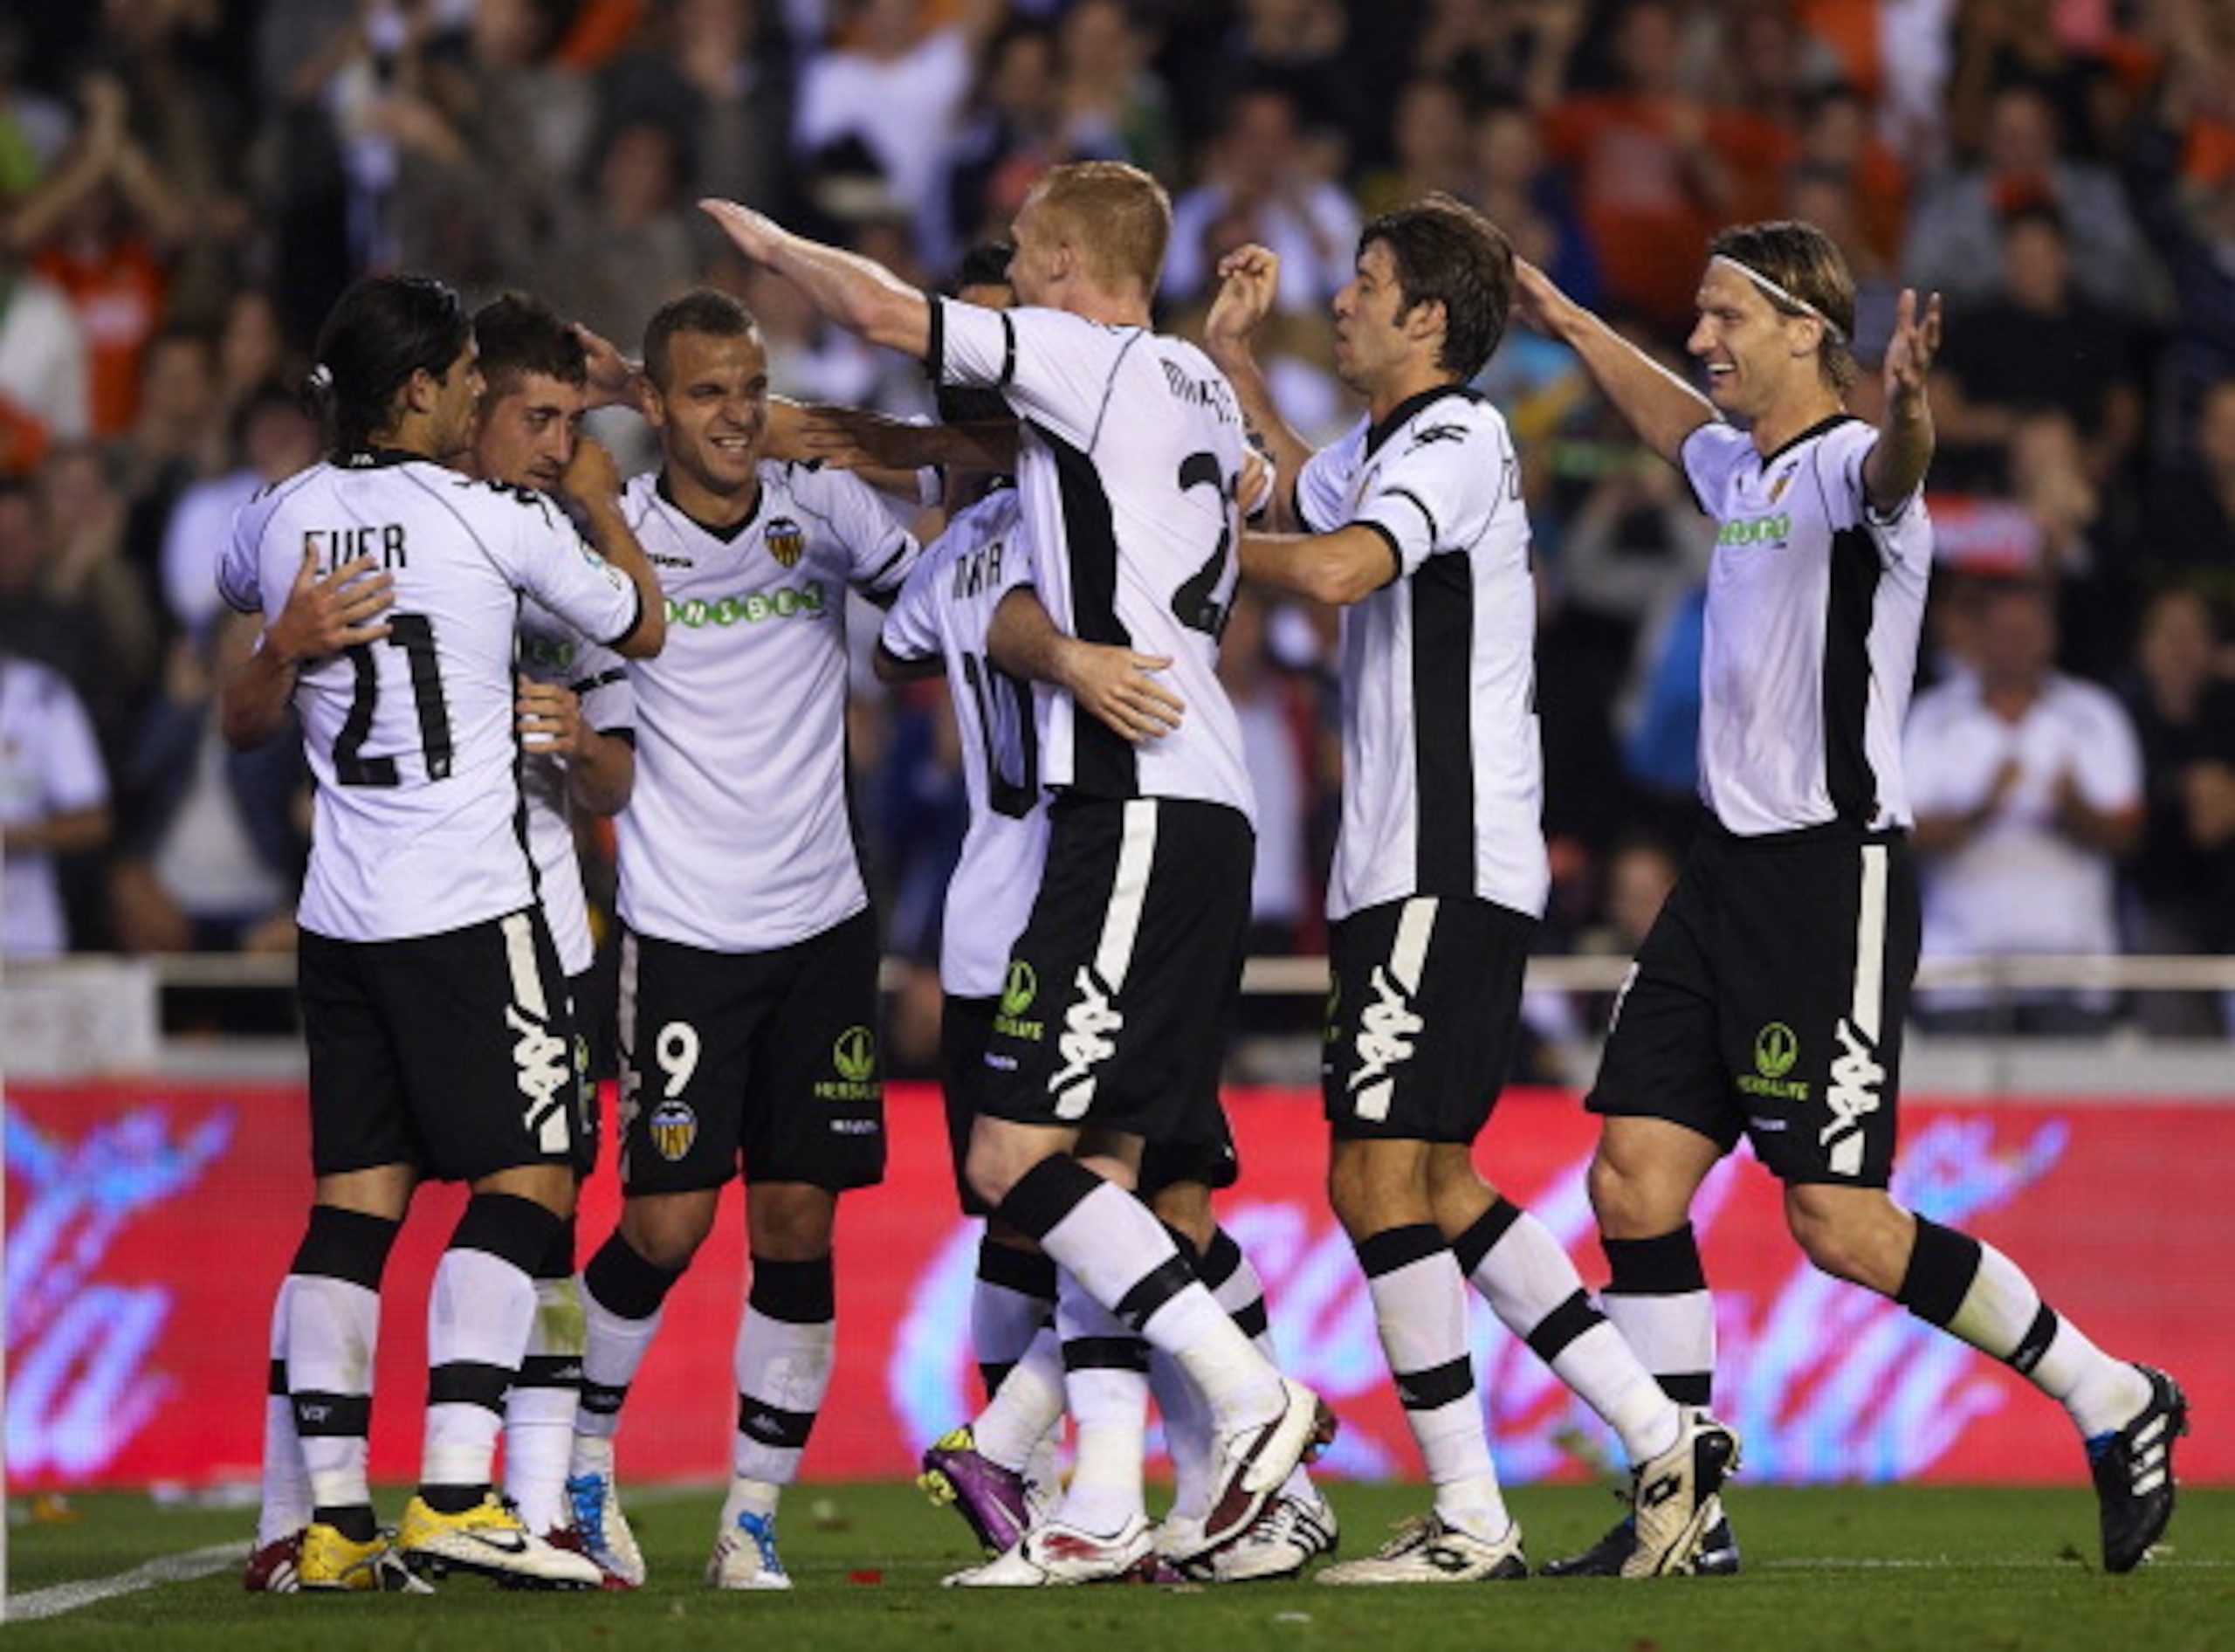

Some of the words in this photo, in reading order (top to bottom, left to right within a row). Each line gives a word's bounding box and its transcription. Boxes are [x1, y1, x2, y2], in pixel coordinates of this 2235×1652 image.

[299, 614, 453, 786] 21
[961, 651, 1039, 819] 10
[657, 1021, 699, 1097] 9
